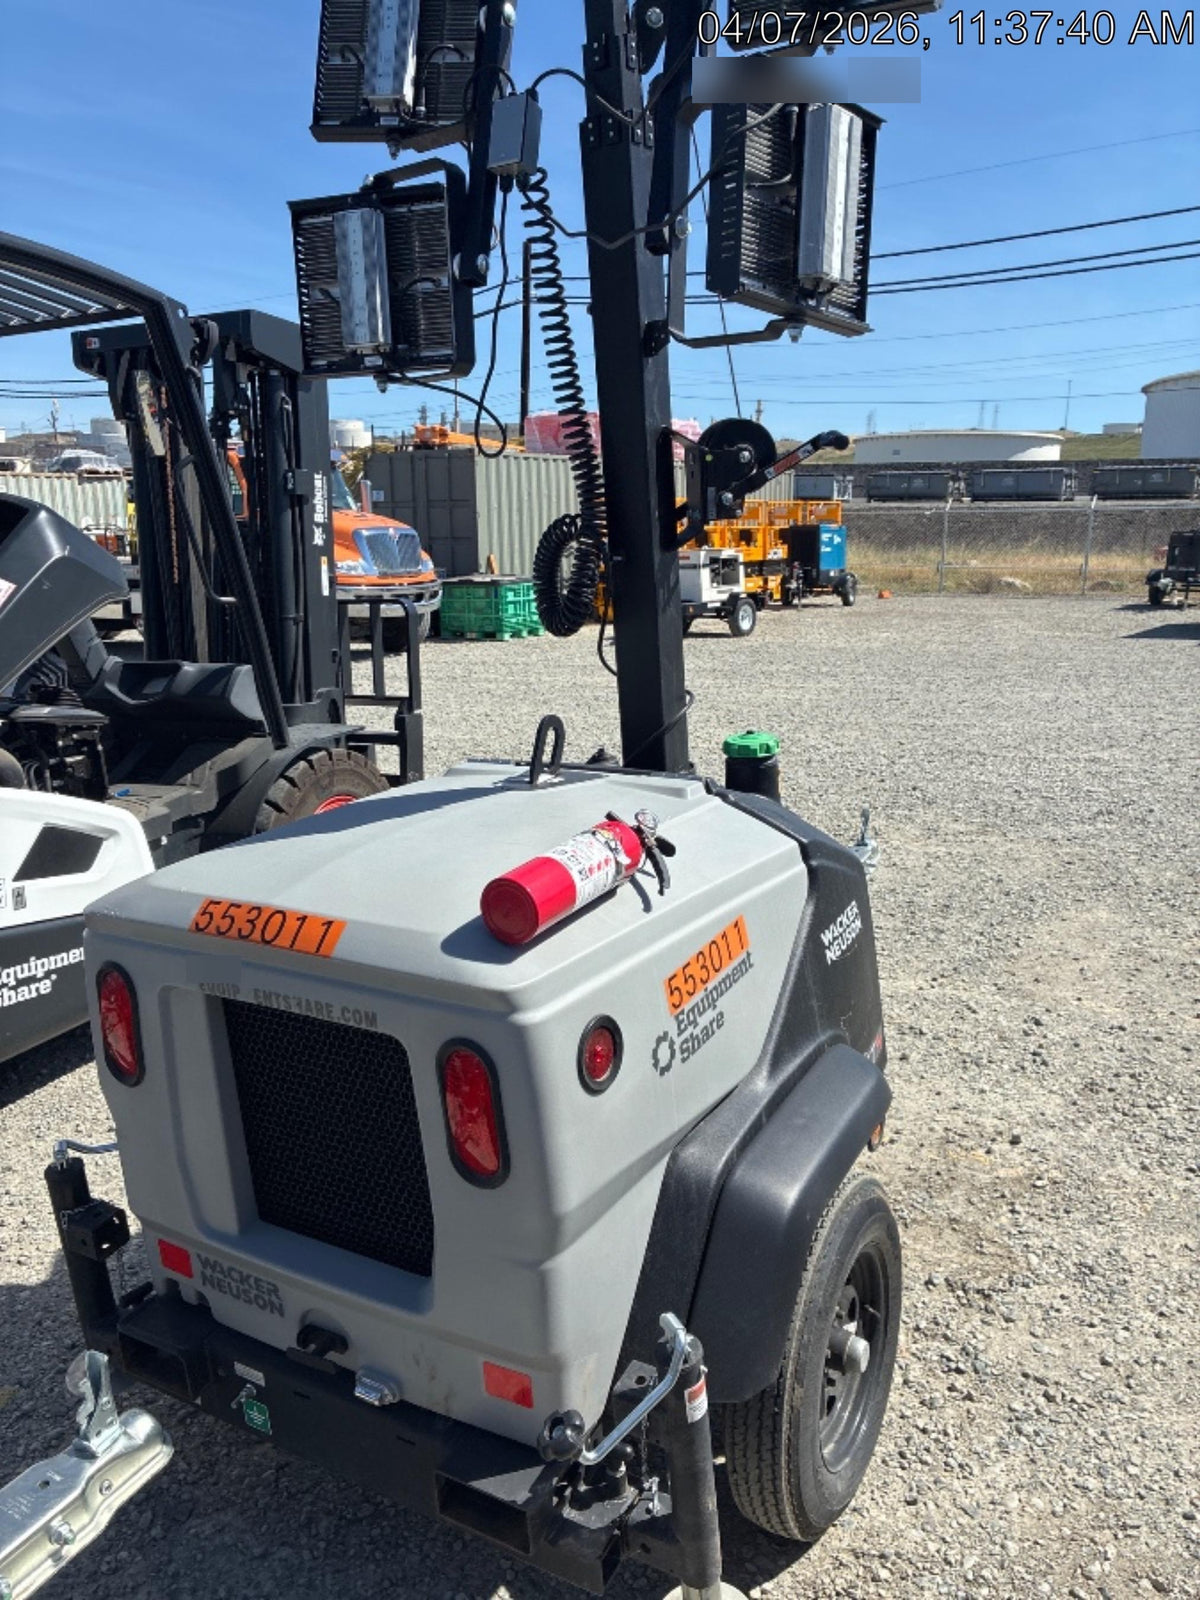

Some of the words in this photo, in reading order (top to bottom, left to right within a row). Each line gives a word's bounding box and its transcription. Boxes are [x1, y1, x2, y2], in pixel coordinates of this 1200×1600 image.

[195, 900, 334, 953] 553011
[820, 900, 862, 946] WACKER
[825, 918, 863, 966] NEUSON
[0, 947, 85, 987] quipme
[668, 920, 744, 1010] 553011
[0, 979, 52, 1008] hare
[674, 950, 754, 1037] Equipment
[679, 1011, 725, 1064] Share
[196, 1252, 283, 1302] WACKER
[201, 1269, 285, 1318] NEUSON
